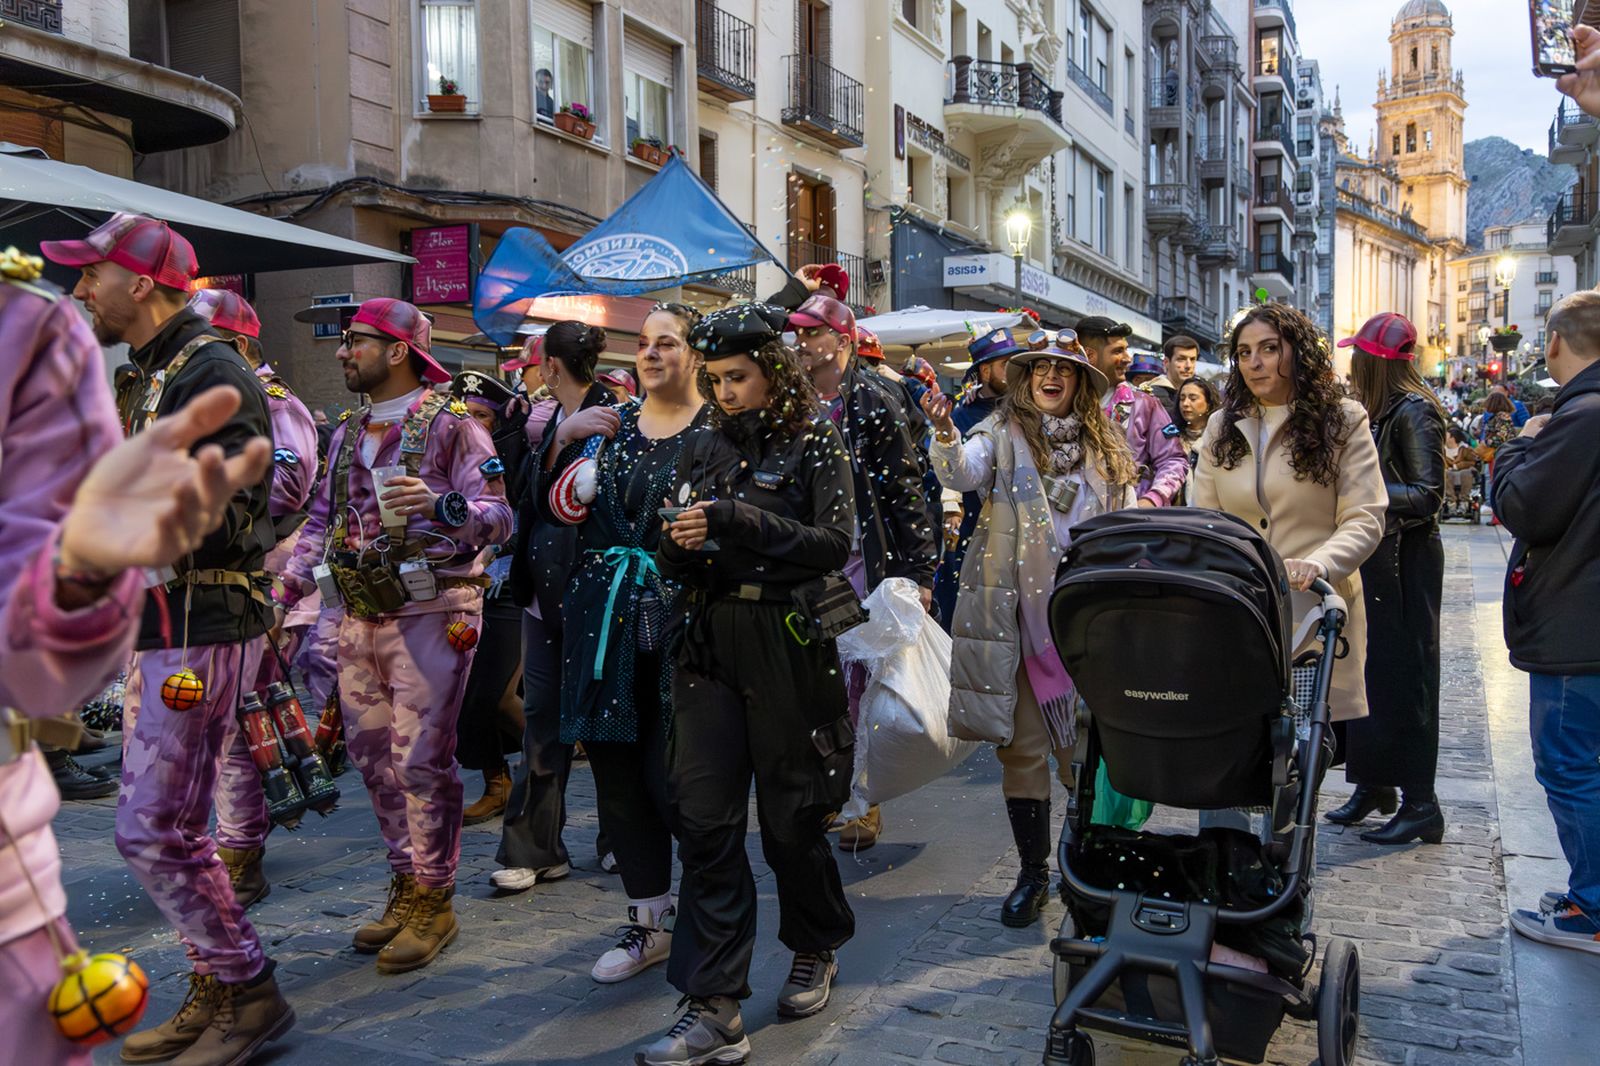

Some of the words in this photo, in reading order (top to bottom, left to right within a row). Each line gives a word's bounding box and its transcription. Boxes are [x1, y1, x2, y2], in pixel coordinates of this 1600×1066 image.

[436, 259, 447, 269] de
[948, 265, 977, 276] asisa
[1124, 689, 1189, 701] easywalker
